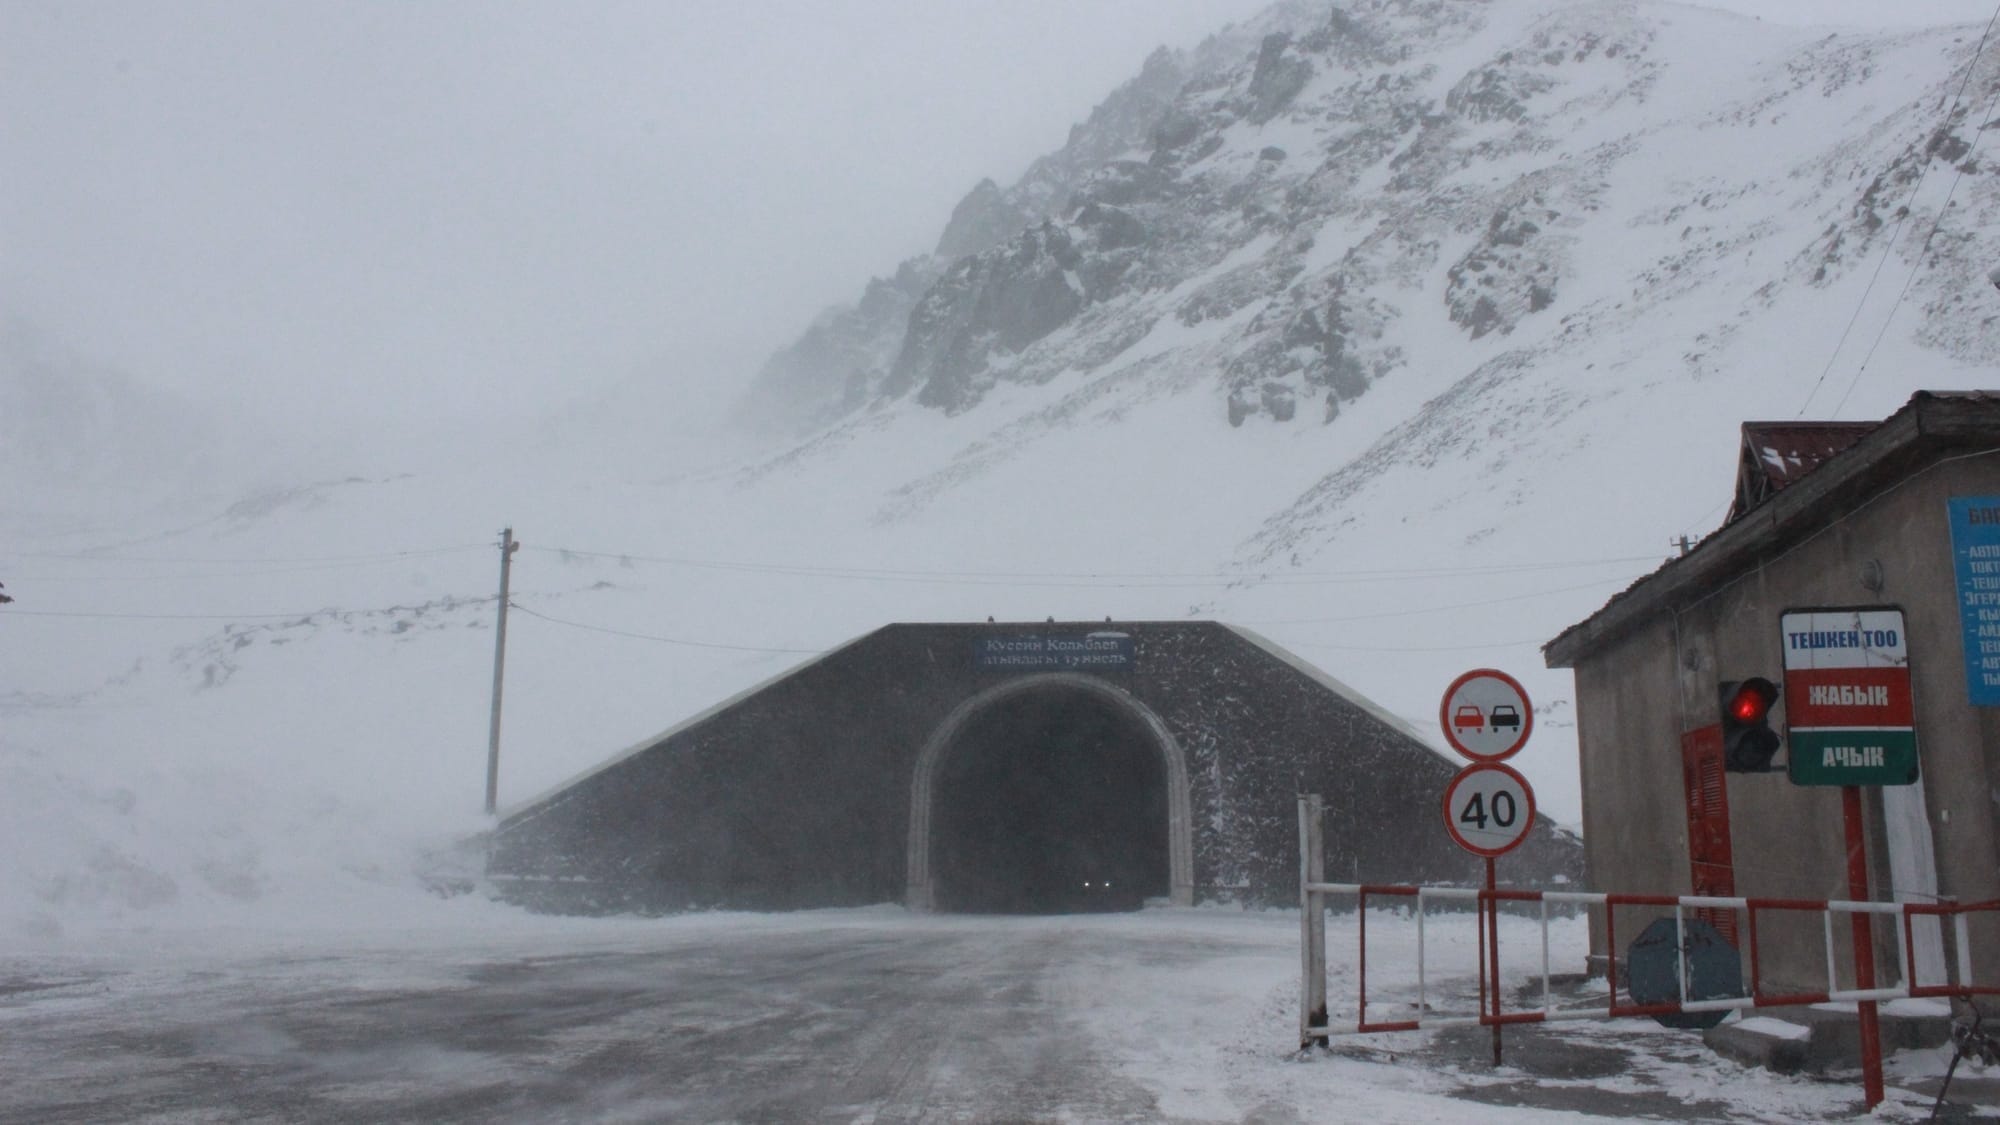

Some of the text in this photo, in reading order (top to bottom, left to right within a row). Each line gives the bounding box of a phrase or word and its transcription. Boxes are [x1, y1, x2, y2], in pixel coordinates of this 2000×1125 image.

[1789, 630, 1898, 649] ТЕШКЕН ТОО
[1809, 685, 1889, 706] ЖАБЫК
[1822, 746, 1885, 768] АЧЫК
[1460, 790, 1516, 829] 40
